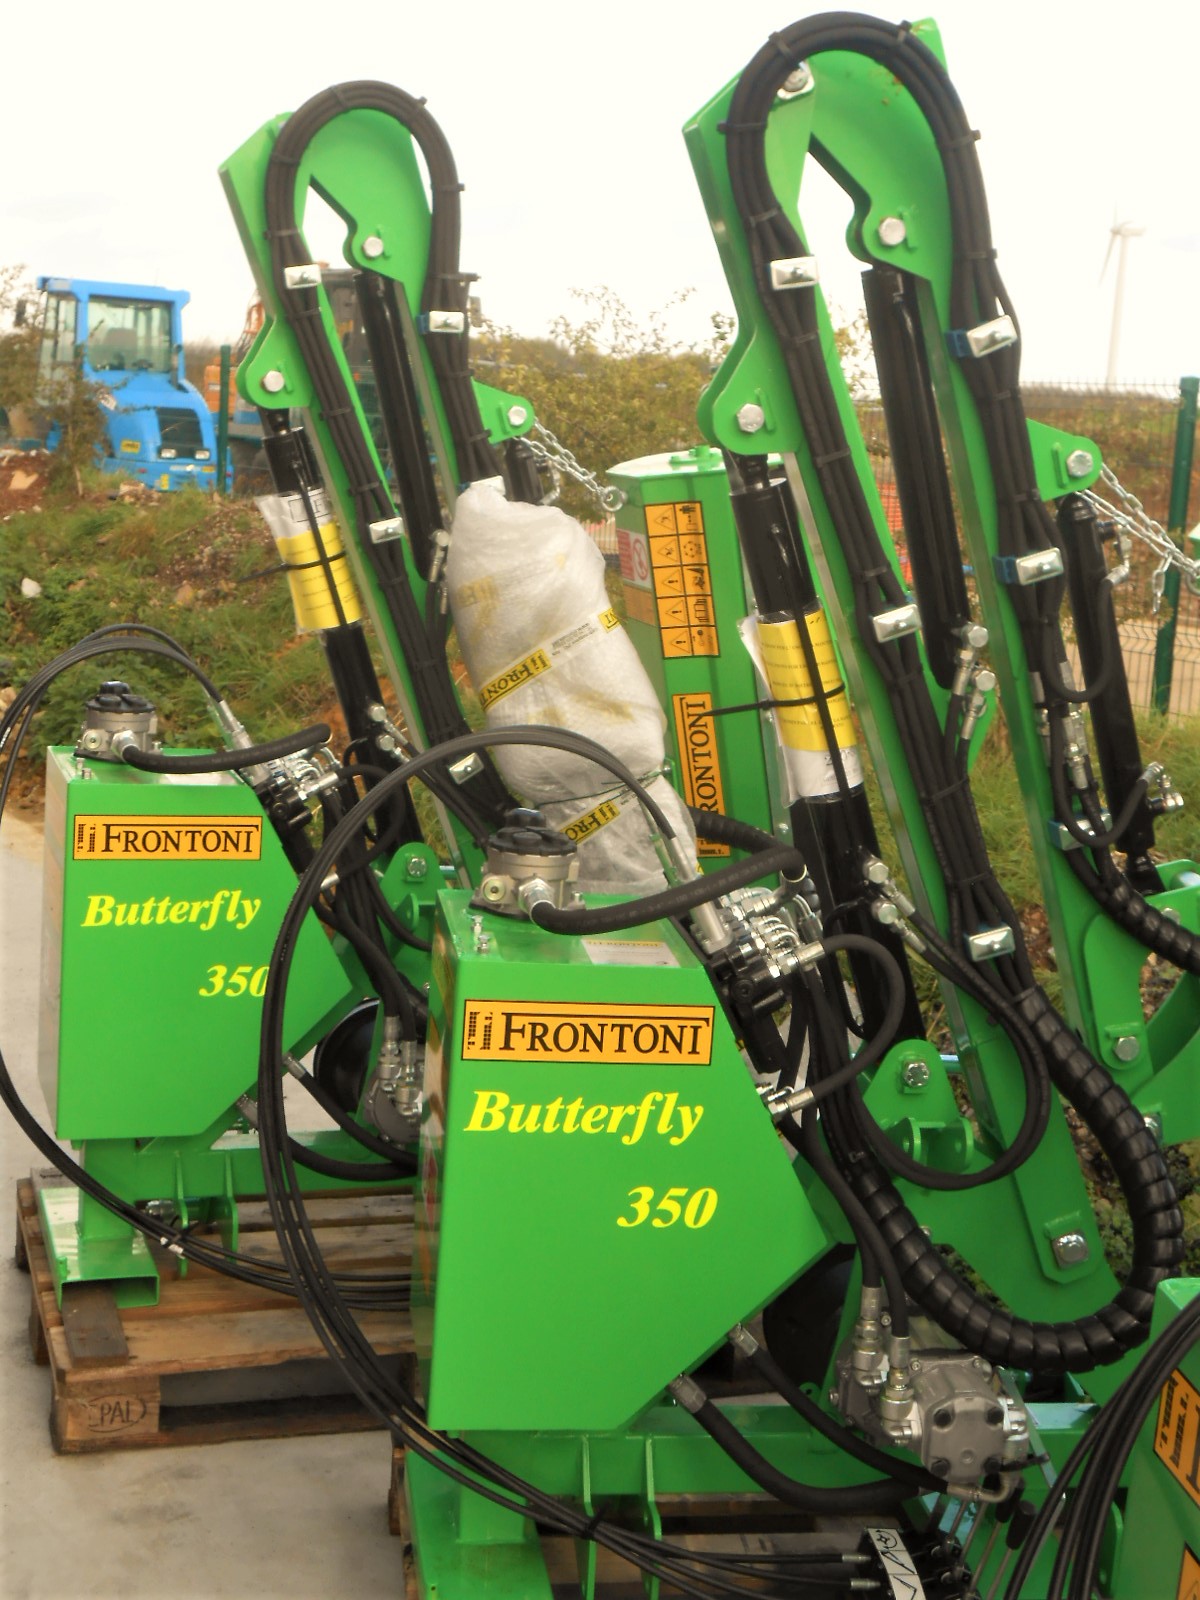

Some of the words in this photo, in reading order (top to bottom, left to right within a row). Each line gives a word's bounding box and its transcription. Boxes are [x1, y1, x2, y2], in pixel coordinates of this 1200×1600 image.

[684, 699, 721, 816] RONTONI
[101, 823, 260, 853] FRONTONI
[80, 890, 261, 931] Butterfly
[499, 1012, 710, 1054] FRONTONI
[463, 1091, 704, 1145] Butterfly
[616, 1186, 719, 1229] 350
